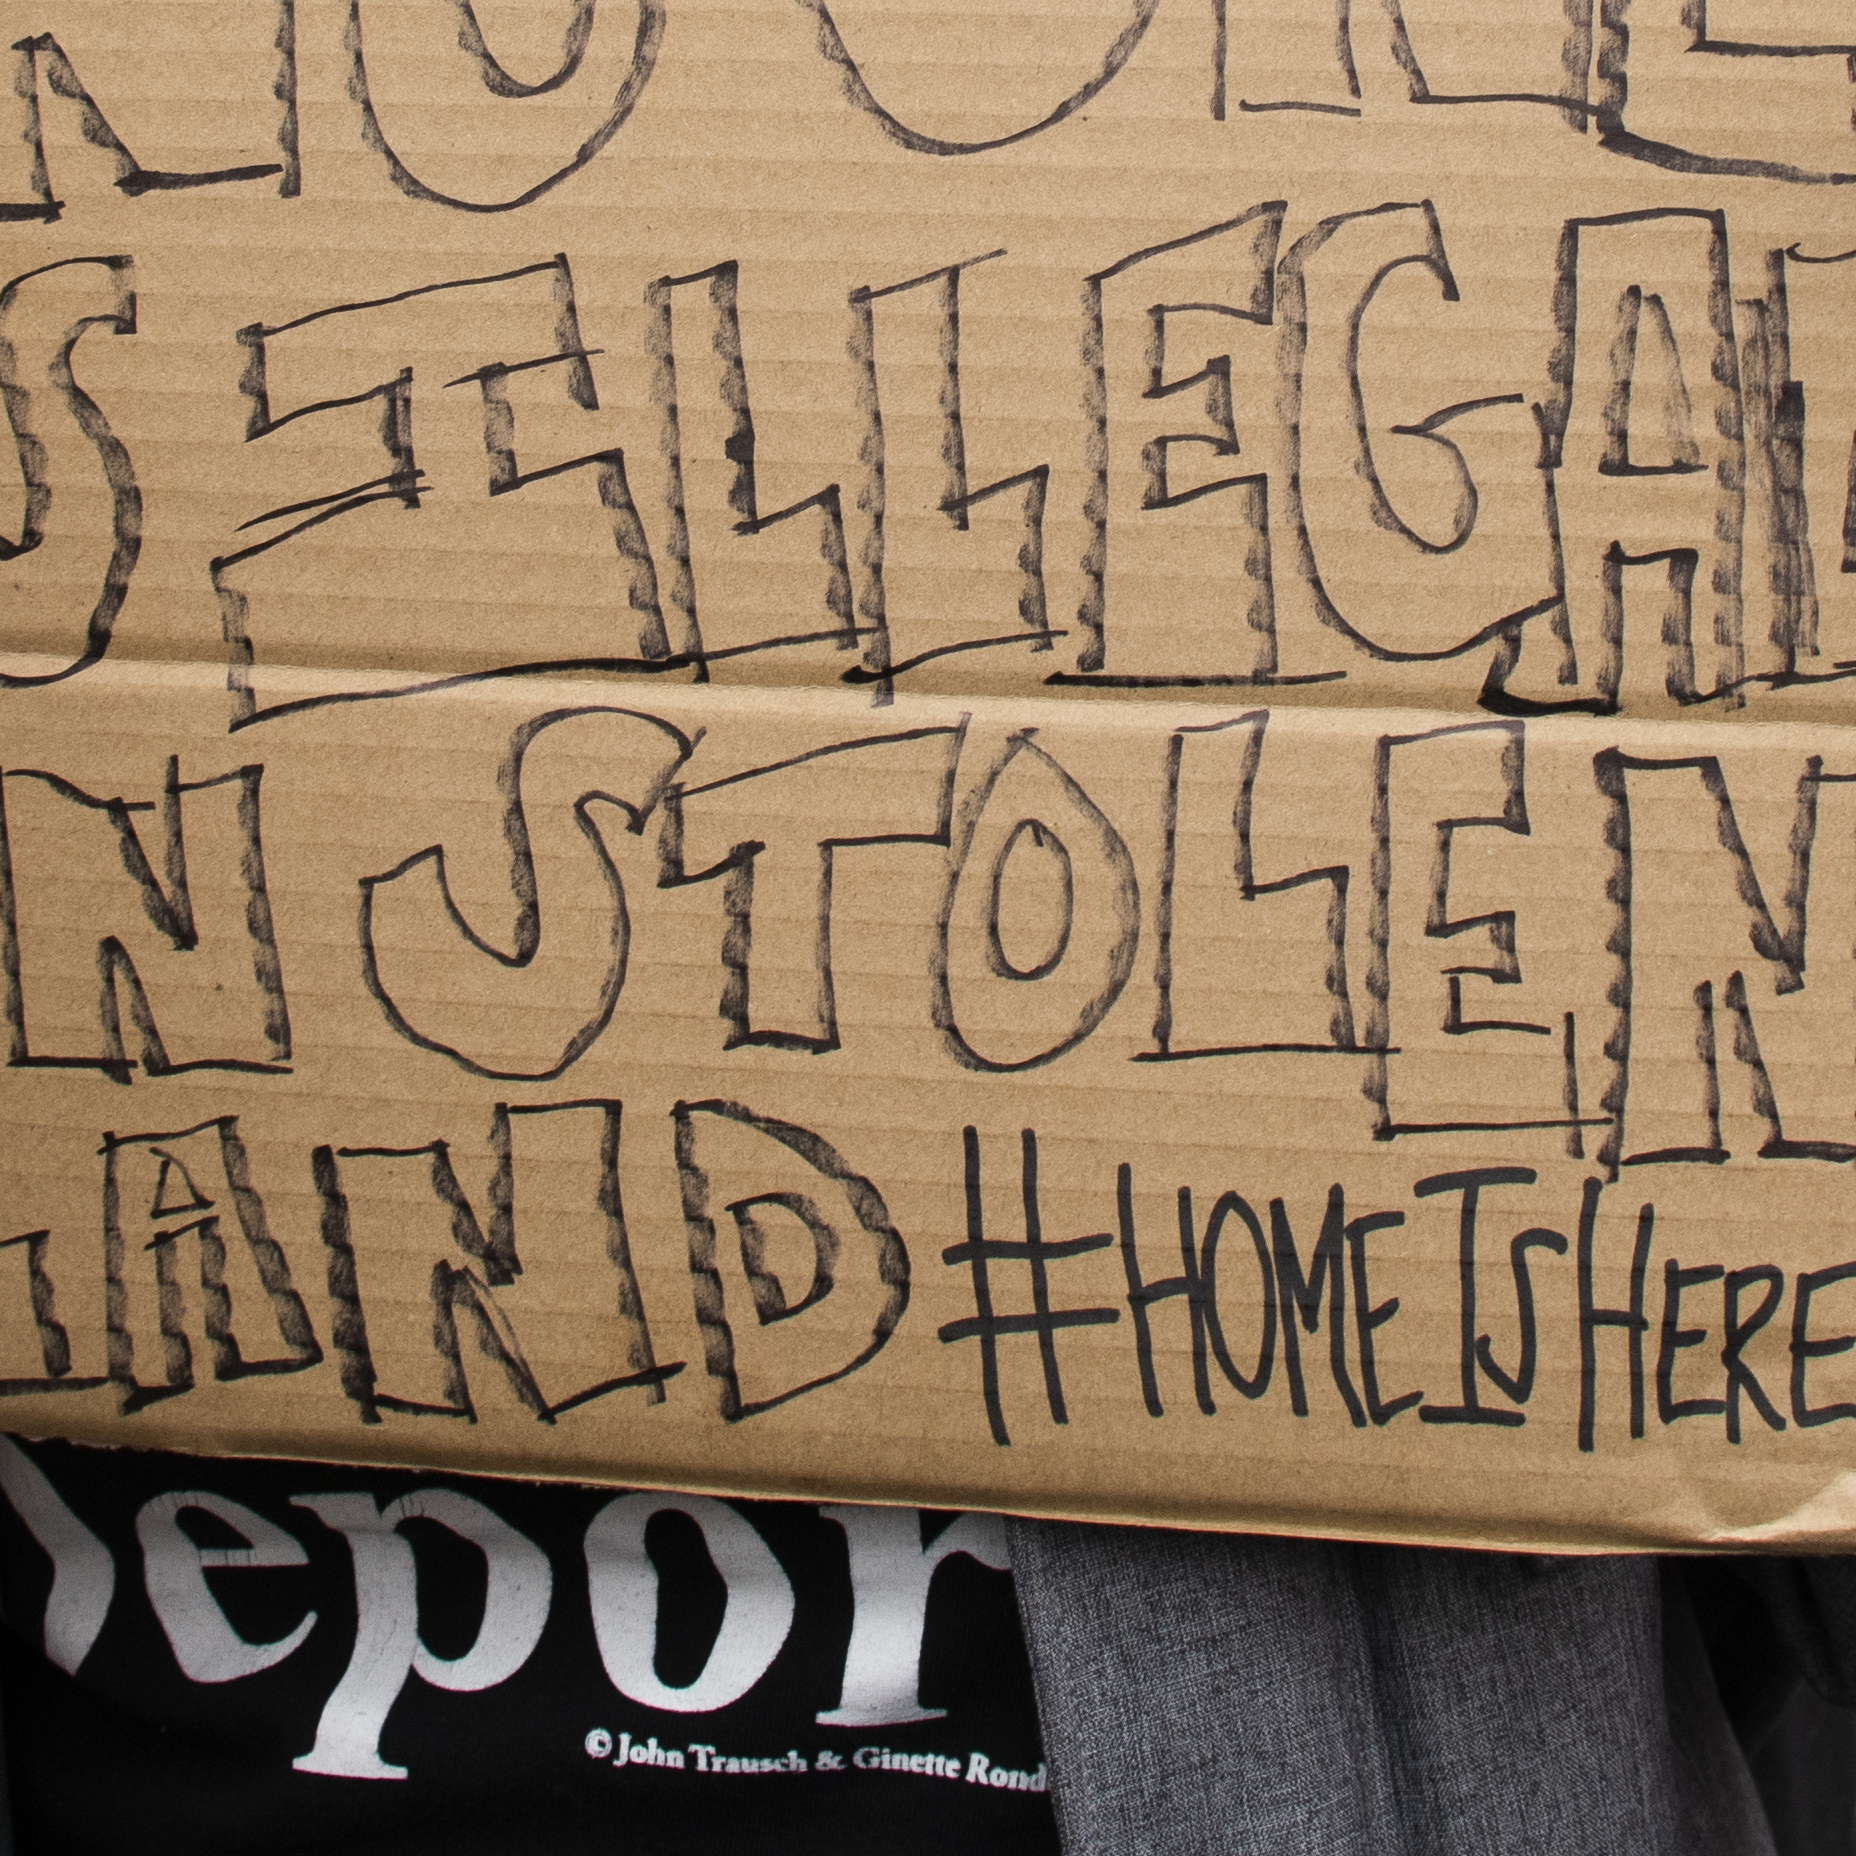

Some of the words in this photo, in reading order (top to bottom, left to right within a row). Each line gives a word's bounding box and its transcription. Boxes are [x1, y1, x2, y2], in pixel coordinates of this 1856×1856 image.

[688, 1743, 808, 1774] Trausch
[814, 1749, 847, 1771] &
[852, 1746, 962, 1781] Ginette
